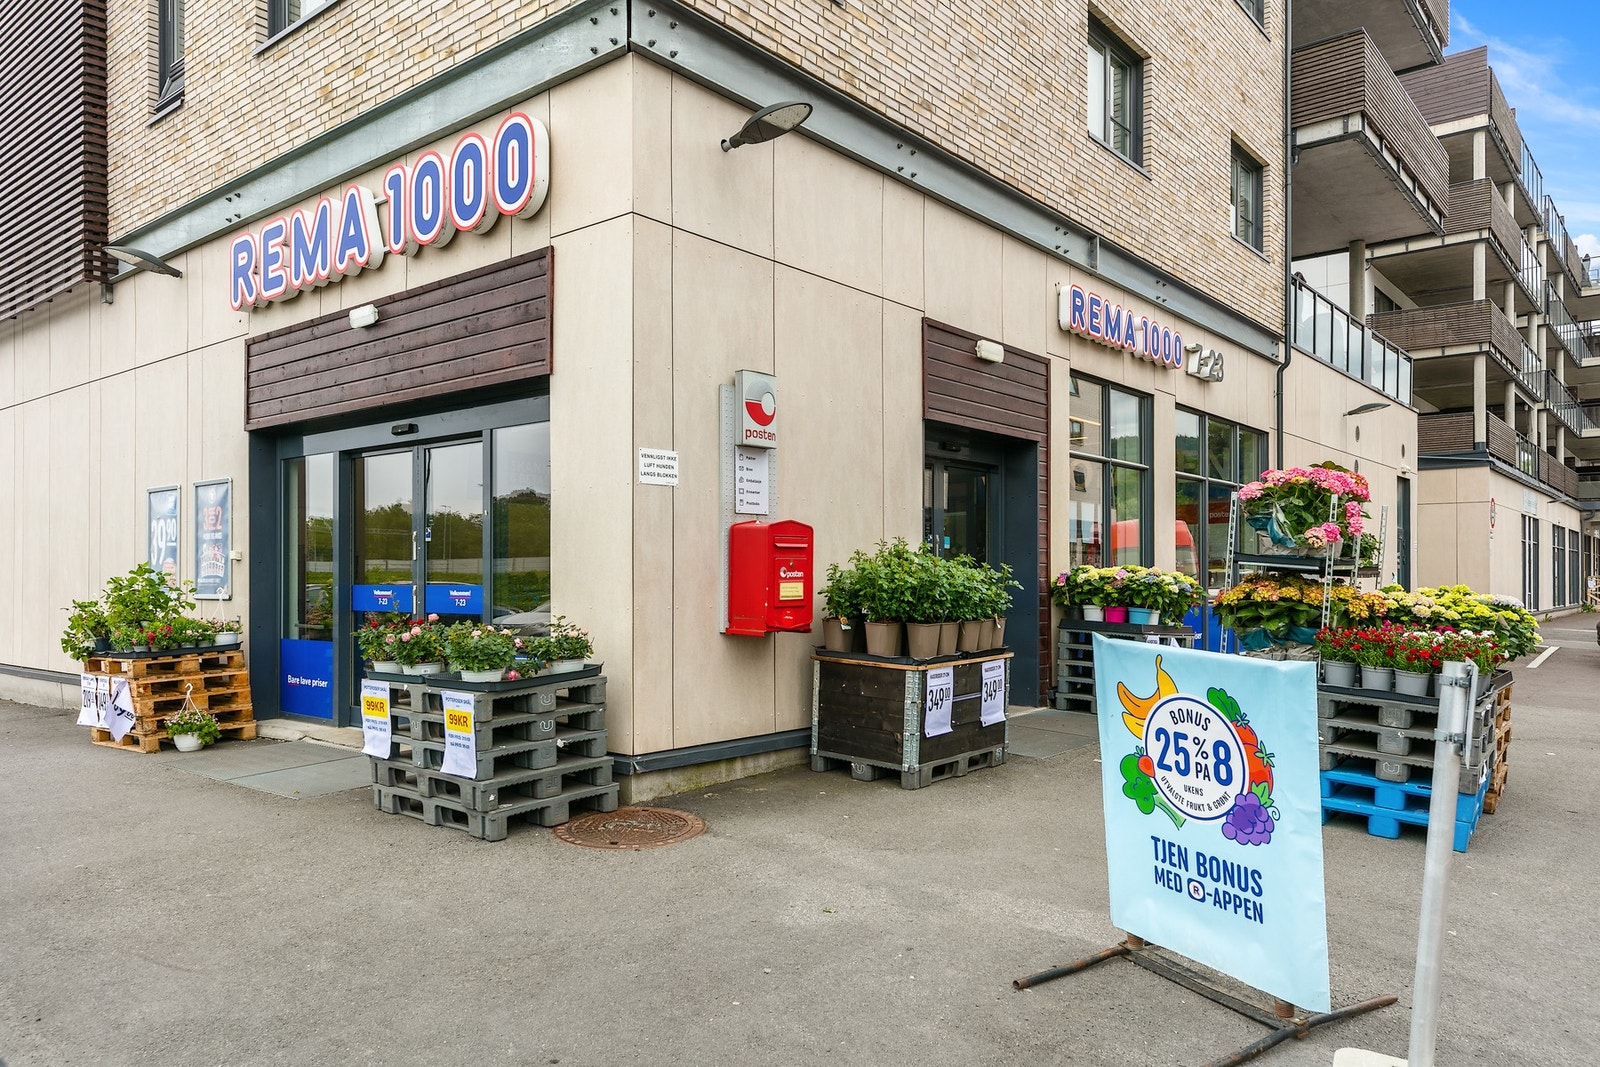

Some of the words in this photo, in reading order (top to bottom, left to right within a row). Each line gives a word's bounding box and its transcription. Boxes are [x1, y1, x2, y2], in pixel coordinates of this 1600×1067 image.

[230, 183, 372, 312] REMA
[383, 112, 536, 255] 1000
[1070, 284, 1137, 353] REMA
[1141, 316, 1183, 369] 1000
[1184, 343, 1224, 383] 7-23
[745, 429, 776, 441] posten
[151, 518, 166, 565] 39
[166, 518, 177, 541] 90
[455, 599, 466, 607] 7-23
[288, 674, 300, 684] Bare
[300, 676, 311, 686] lave
[312, 678, 328, 688] priser
[984, 680, 997, 703] 349
[366, 700, 385, 712] 99KR
[928, 688, 944, 712] 349
[945, 687, 951, 698] 00
[449, 714, 468, 727] 99KR
[1169, 708, 1211, 731] BONUS
[1155, 727, 1191, 777] 25
[1193, 736, 1209, 760] %
[1212, 740, 1233, 786] 8
[1160, 775, 1184, 805] UTVALGTE
[1186, 801, 1205, 812] FRUKT
[1207, 802, 1213, 812] &
[1213, 791, 1231, 809] GRØNT
[1183, 784, 1204, 797] UKENS
[1151, 835, 1188, 872] TJEN
[1196, 851, 1263, 897] BONUS
[1154, 865, 1183, 893] MED
